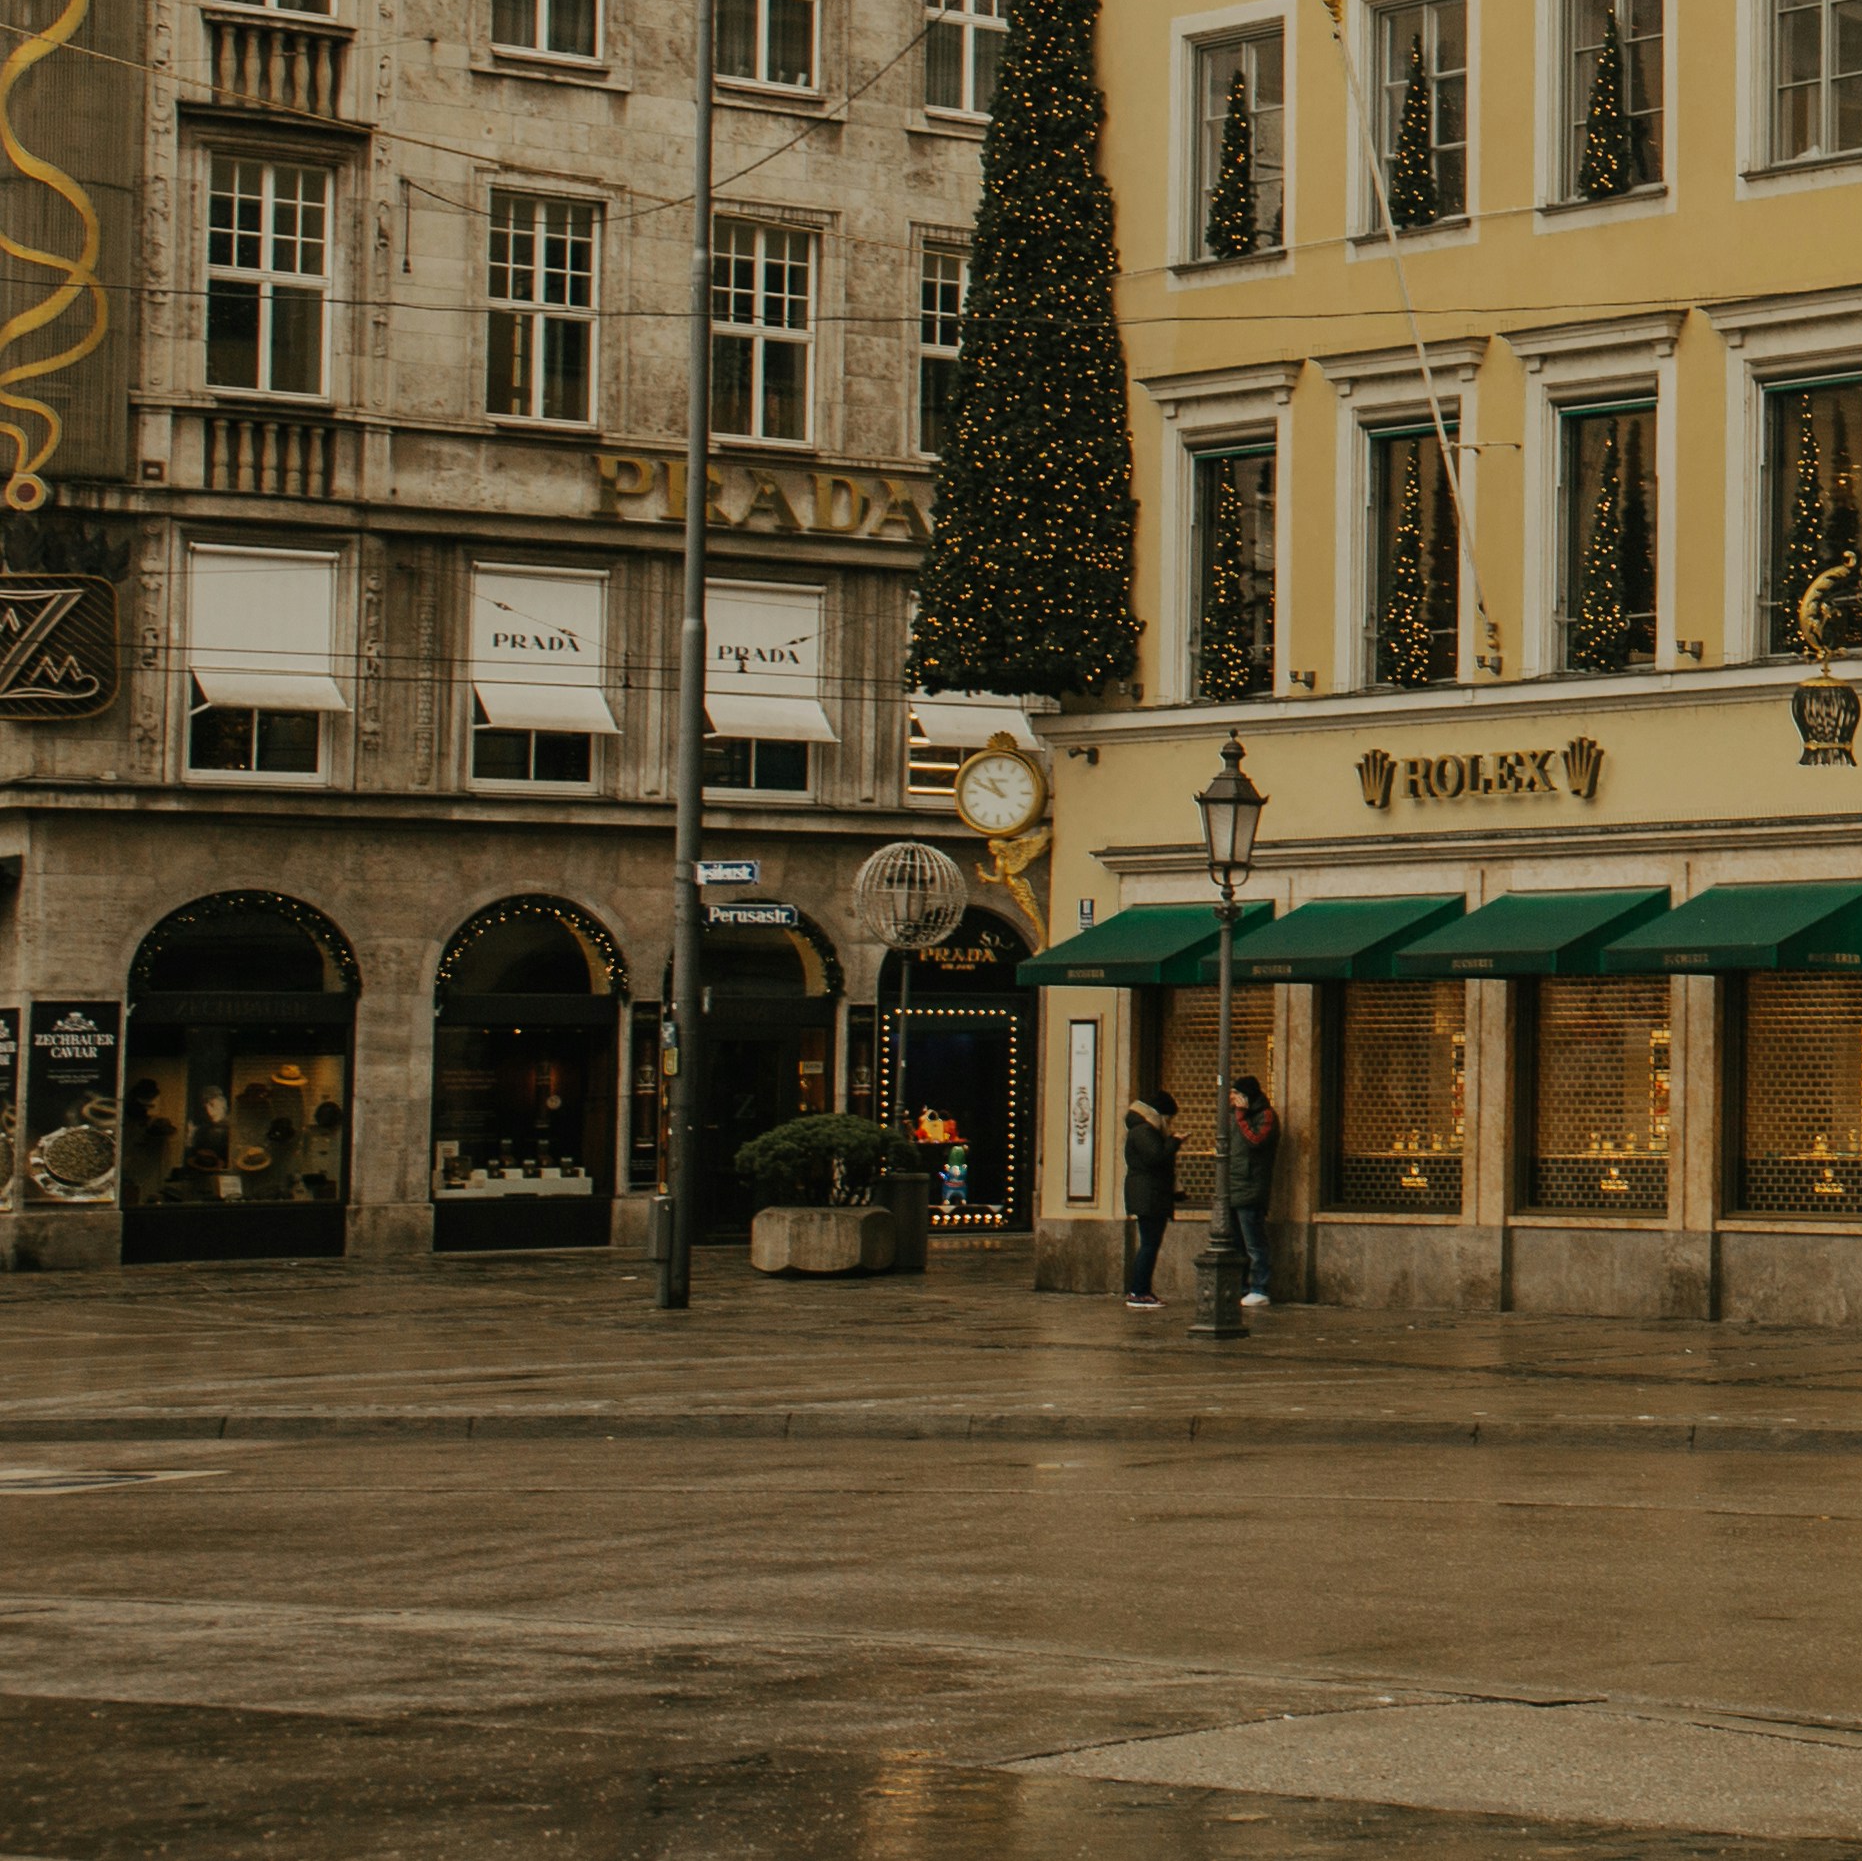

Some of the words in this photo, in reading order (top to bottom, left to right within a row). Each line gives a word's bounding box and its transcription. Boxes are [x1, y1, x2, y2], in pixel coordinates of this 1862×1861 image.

[593, 454, 937, 536] PRADA
[492, 632, 580, 653] PRADA
[718, 645, 800, 666] PRADA
[1400, 749, 1557, 799] ROLEX
[709, 906, 792, 924] Perusastr.
[918, 946, 998, 963] PRADA
[34, 1033, 115, 1047] ZECHBAUER
[50, 1045, 98, 1058] CAVIAR
